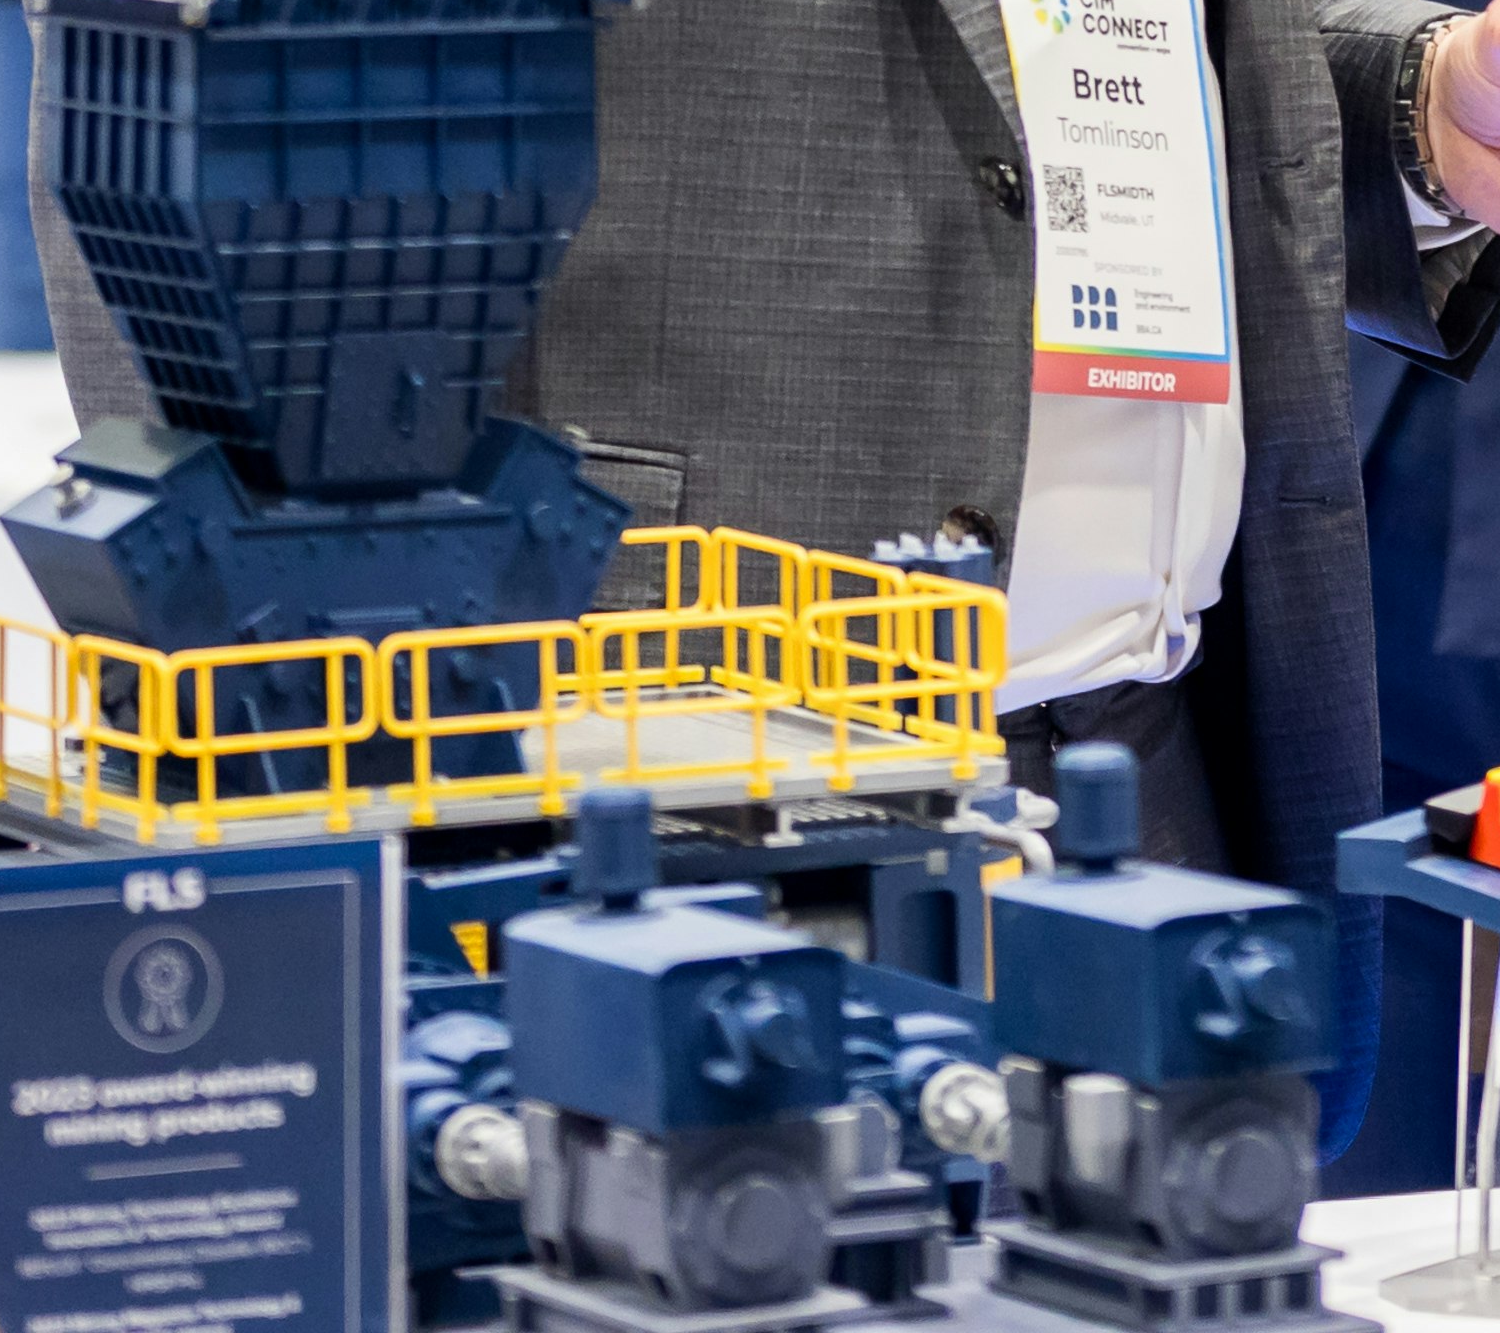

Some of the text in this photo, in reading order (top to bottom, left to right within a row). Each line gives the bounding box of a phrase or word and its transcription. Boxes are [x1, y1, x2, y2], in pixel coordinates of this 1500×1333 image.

[1083, 13, 1168, 42] CONNECT
[1073, 68, 1145, 105] Brett
[1056, 116, 1169, 151] Tomlinson
[1088, 367, 1176, 393] EXHIBITOR
